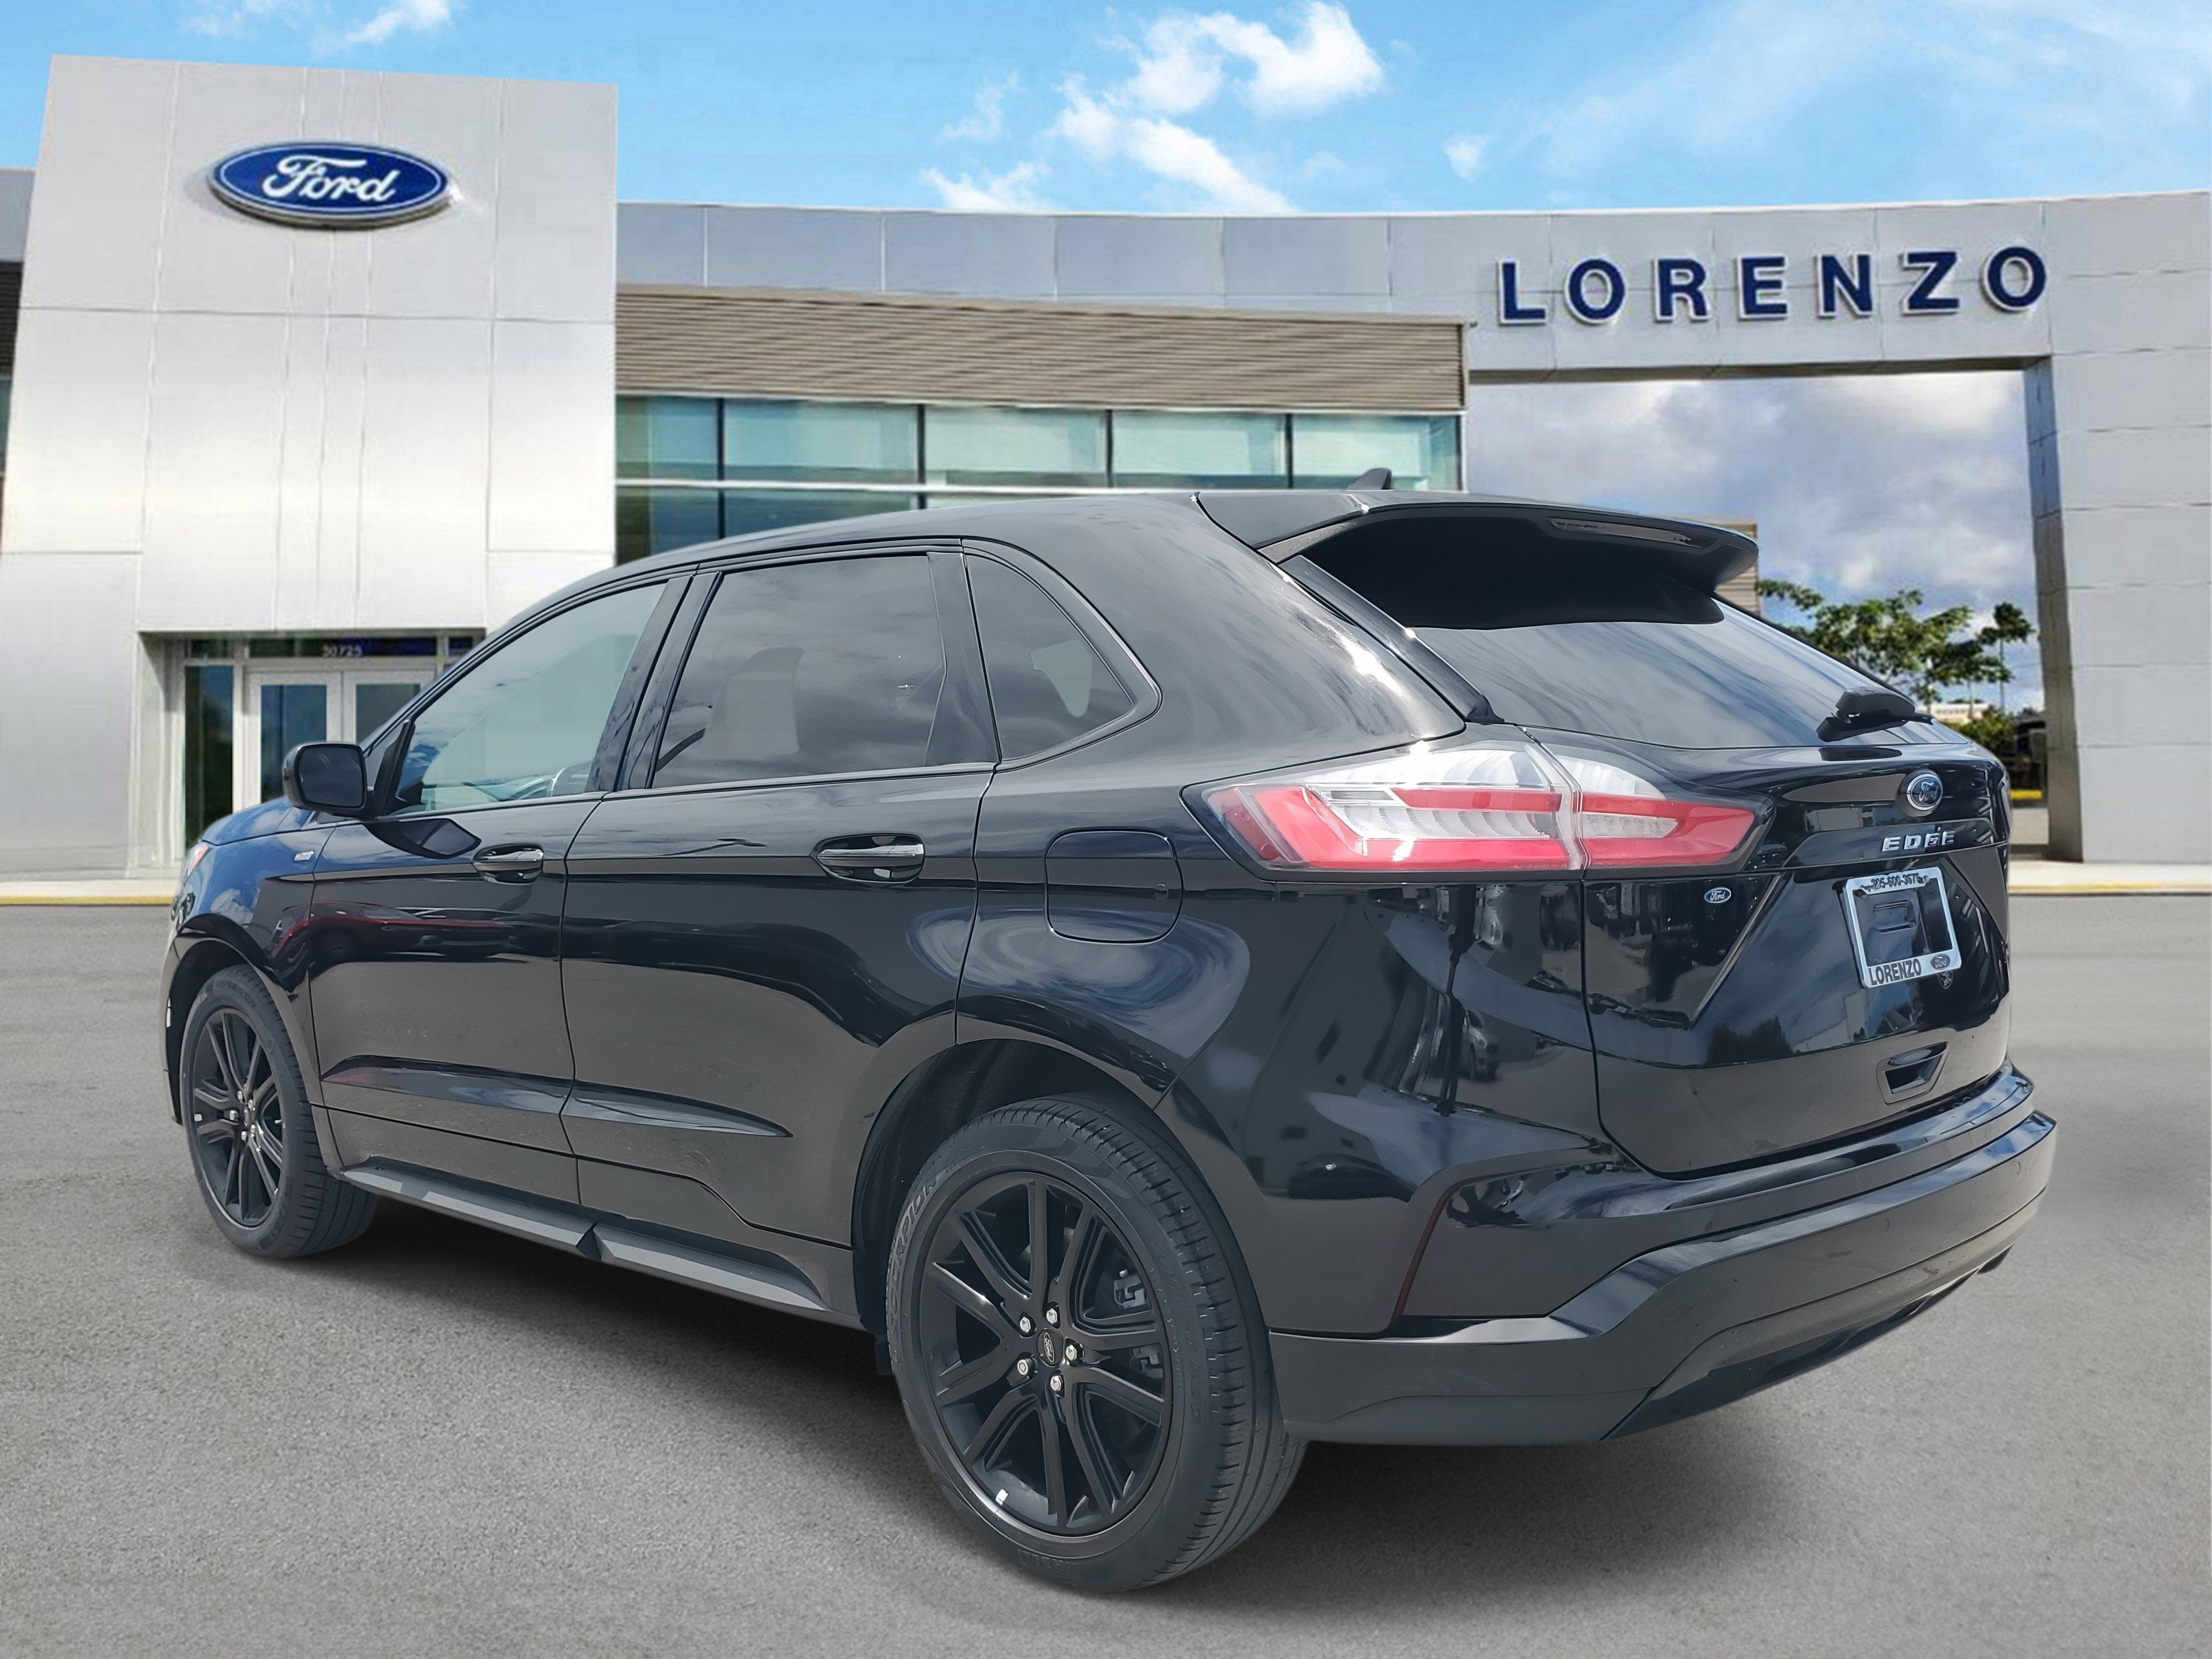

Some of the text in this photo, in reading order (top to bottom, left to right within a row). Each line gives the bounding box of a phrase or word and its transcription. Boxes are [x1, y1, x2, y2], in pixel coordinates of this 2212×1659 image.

[262, 155, 400, 202] Ford
[1498, 247, 2047, 324] LORENZO
[1882, 830, 1956, 852] EDGE
[1709, 890, 1726, 901] Ford
[1868, 958, 1922, 986] LORENZO
[1044, 1337, 1053, 1357] Ford
